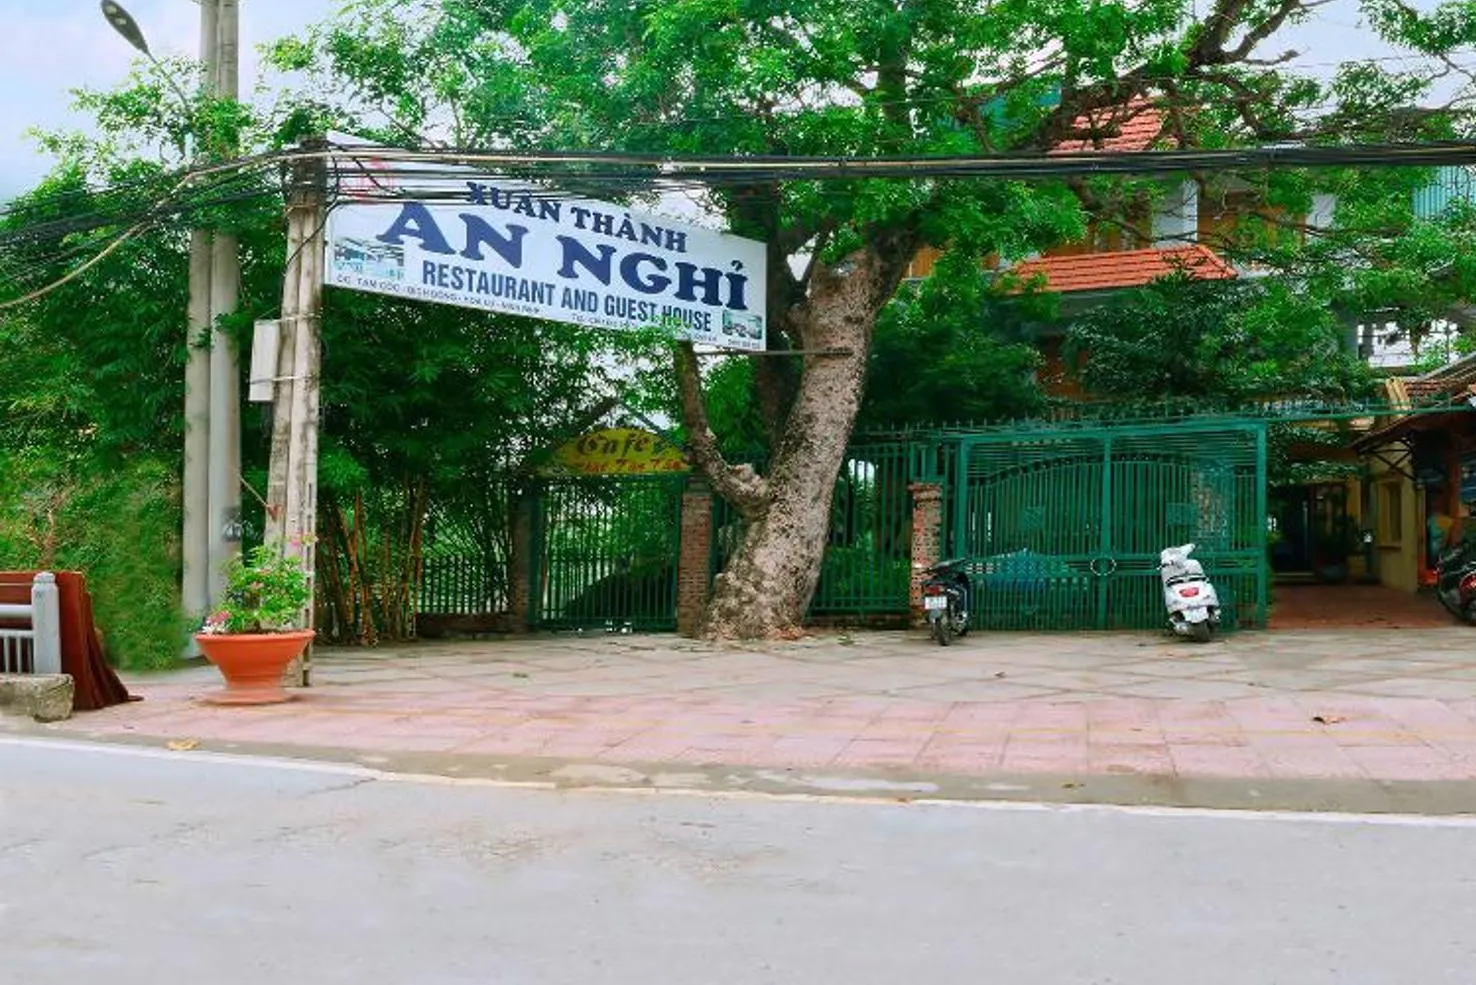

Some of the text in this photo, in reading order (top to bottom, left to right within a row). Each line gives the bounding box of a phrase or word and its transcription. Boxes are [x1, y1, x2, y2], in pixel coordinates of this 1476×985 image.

[375, 201, 529, 269] AN
[556, 233, 749, 310] NGHỈ
[570, 206, 687, 253] THÀNH
[422, 259, 555, 307] RESTAURANT
[561, 287, 598, 313] AND
[604, 294, 658, 323] GUEST
[661, 305, 712, 333] HOUSE
